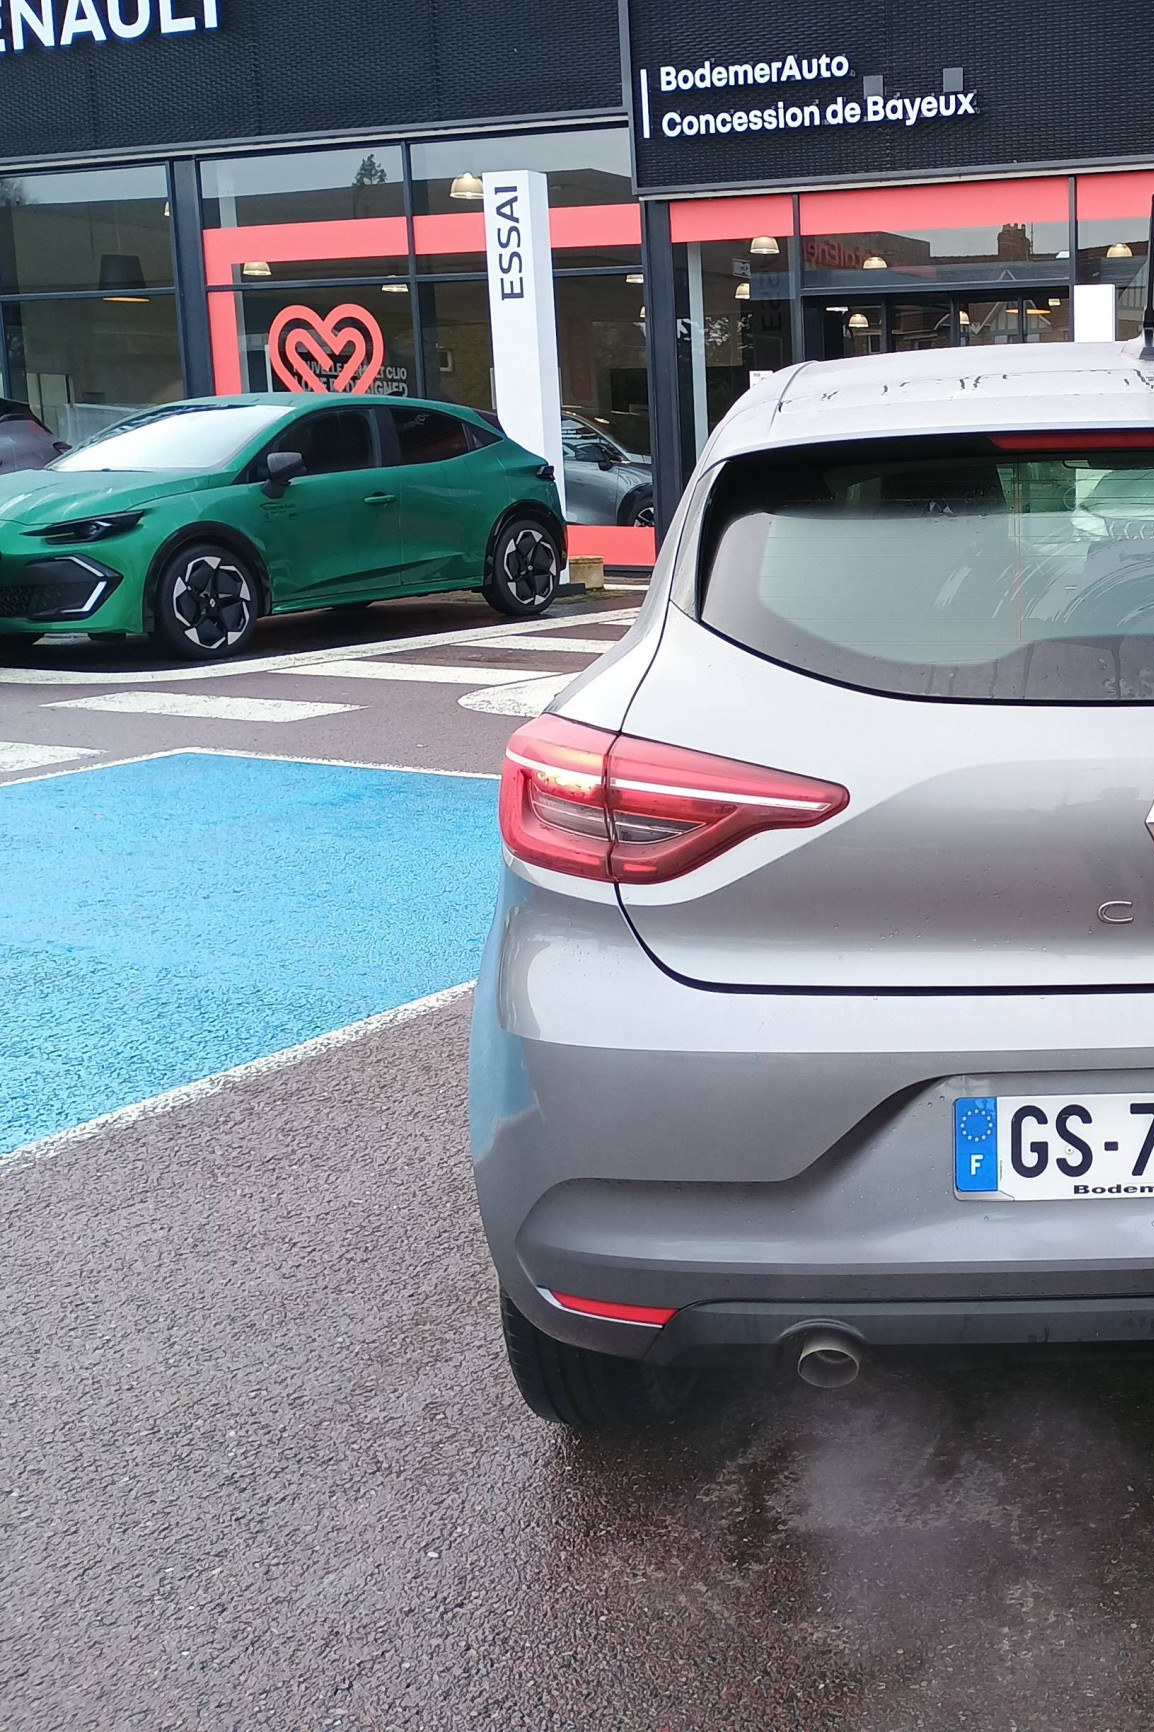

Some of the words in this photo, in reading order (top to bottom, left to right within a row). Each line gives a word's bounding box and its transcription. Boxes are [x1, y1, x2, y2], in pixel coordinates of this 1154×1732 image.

[0, 0, 218, 50] NAUL
[660, 55, 849, 91] BodemerAuto
[661, 101, 821, 138] Concession
[825, 97, 861, 125] de
[867, 93, 976, 125] Bayeux
[494, 186, 524, 301] ESSAI
[386, 366, 407, 379] CLIO
[970, 1154, 984, 1176] F
